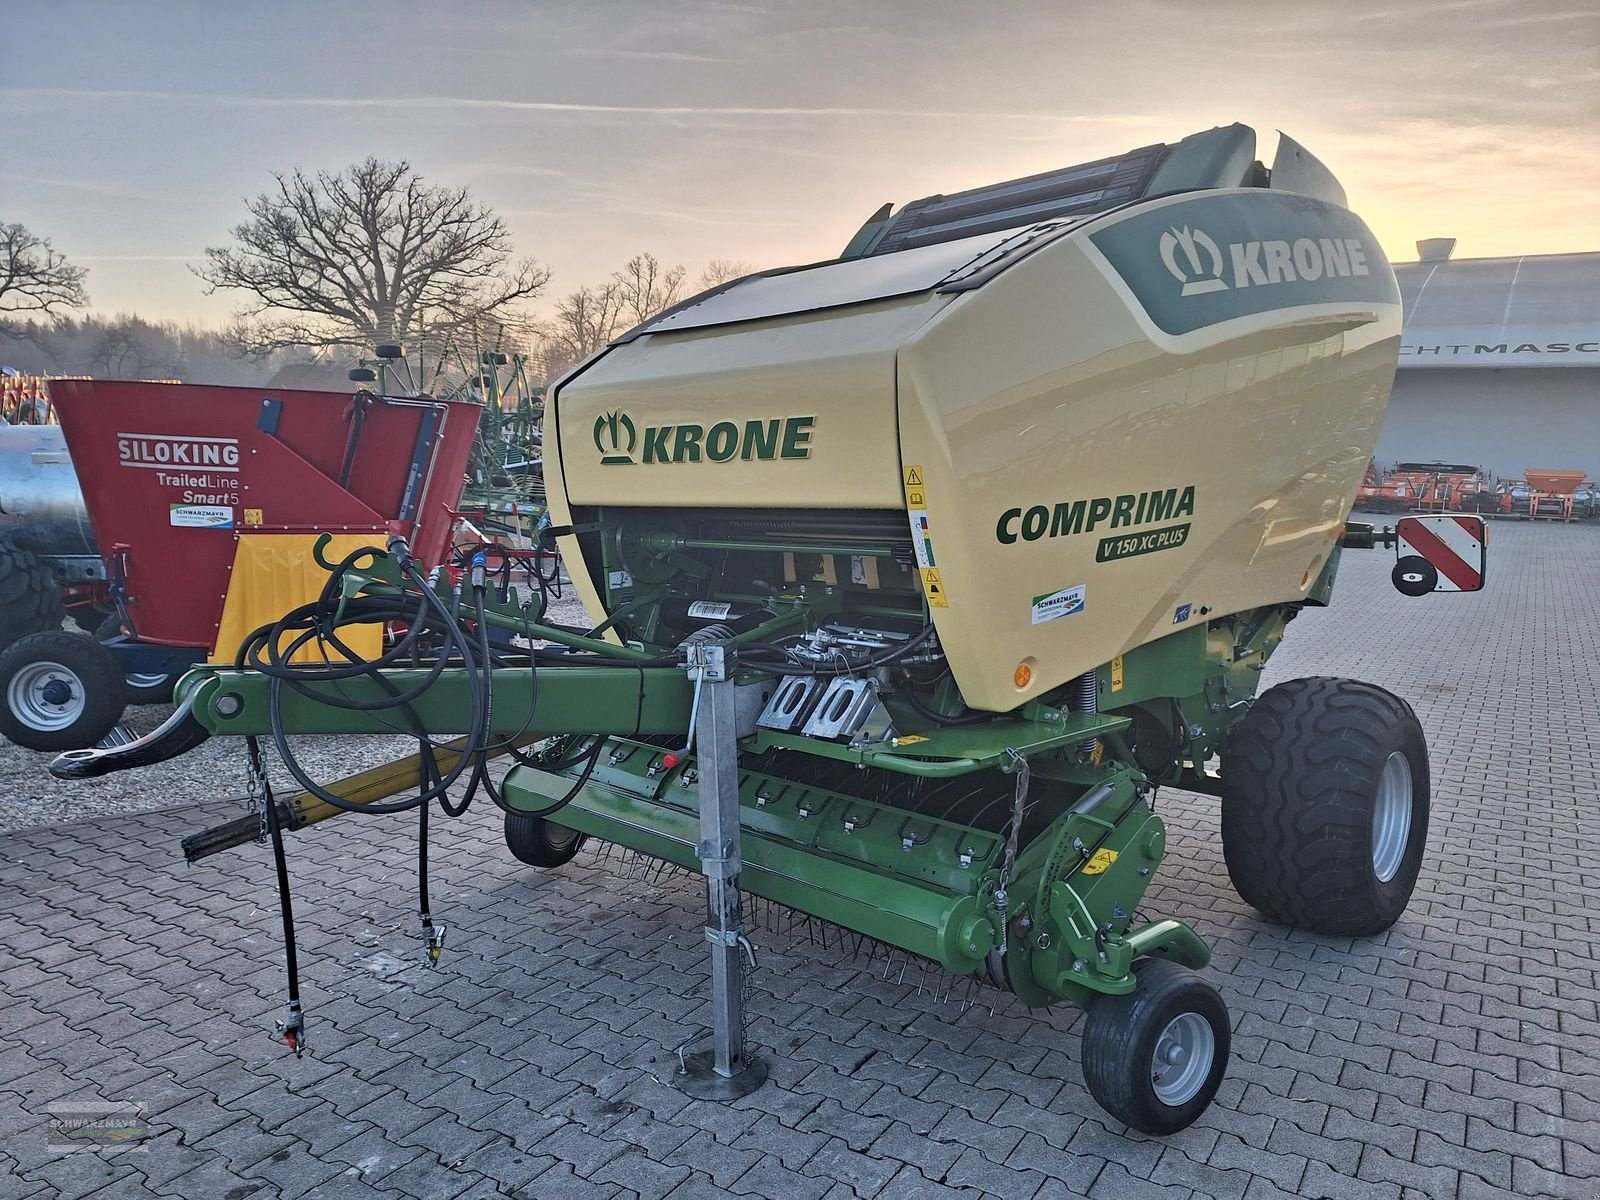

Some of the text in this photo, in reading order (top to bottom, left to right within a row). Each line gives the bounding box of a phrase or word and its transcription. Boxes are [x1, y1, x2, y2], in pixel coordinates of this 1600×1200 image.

[1229, 238, 1369, 288] KRONE
[118, 440, 240, 465] SILOKING
[642, 415, 816, 464] KRONE
[156, 472, 239, 489] TrailedLine
[175, 509, 224, 517] SCHWARZMAYR
[996, 486, 1195, 544] COMPRIMA
[1104, 529, 1185, 557] V 150 XC PLUS
